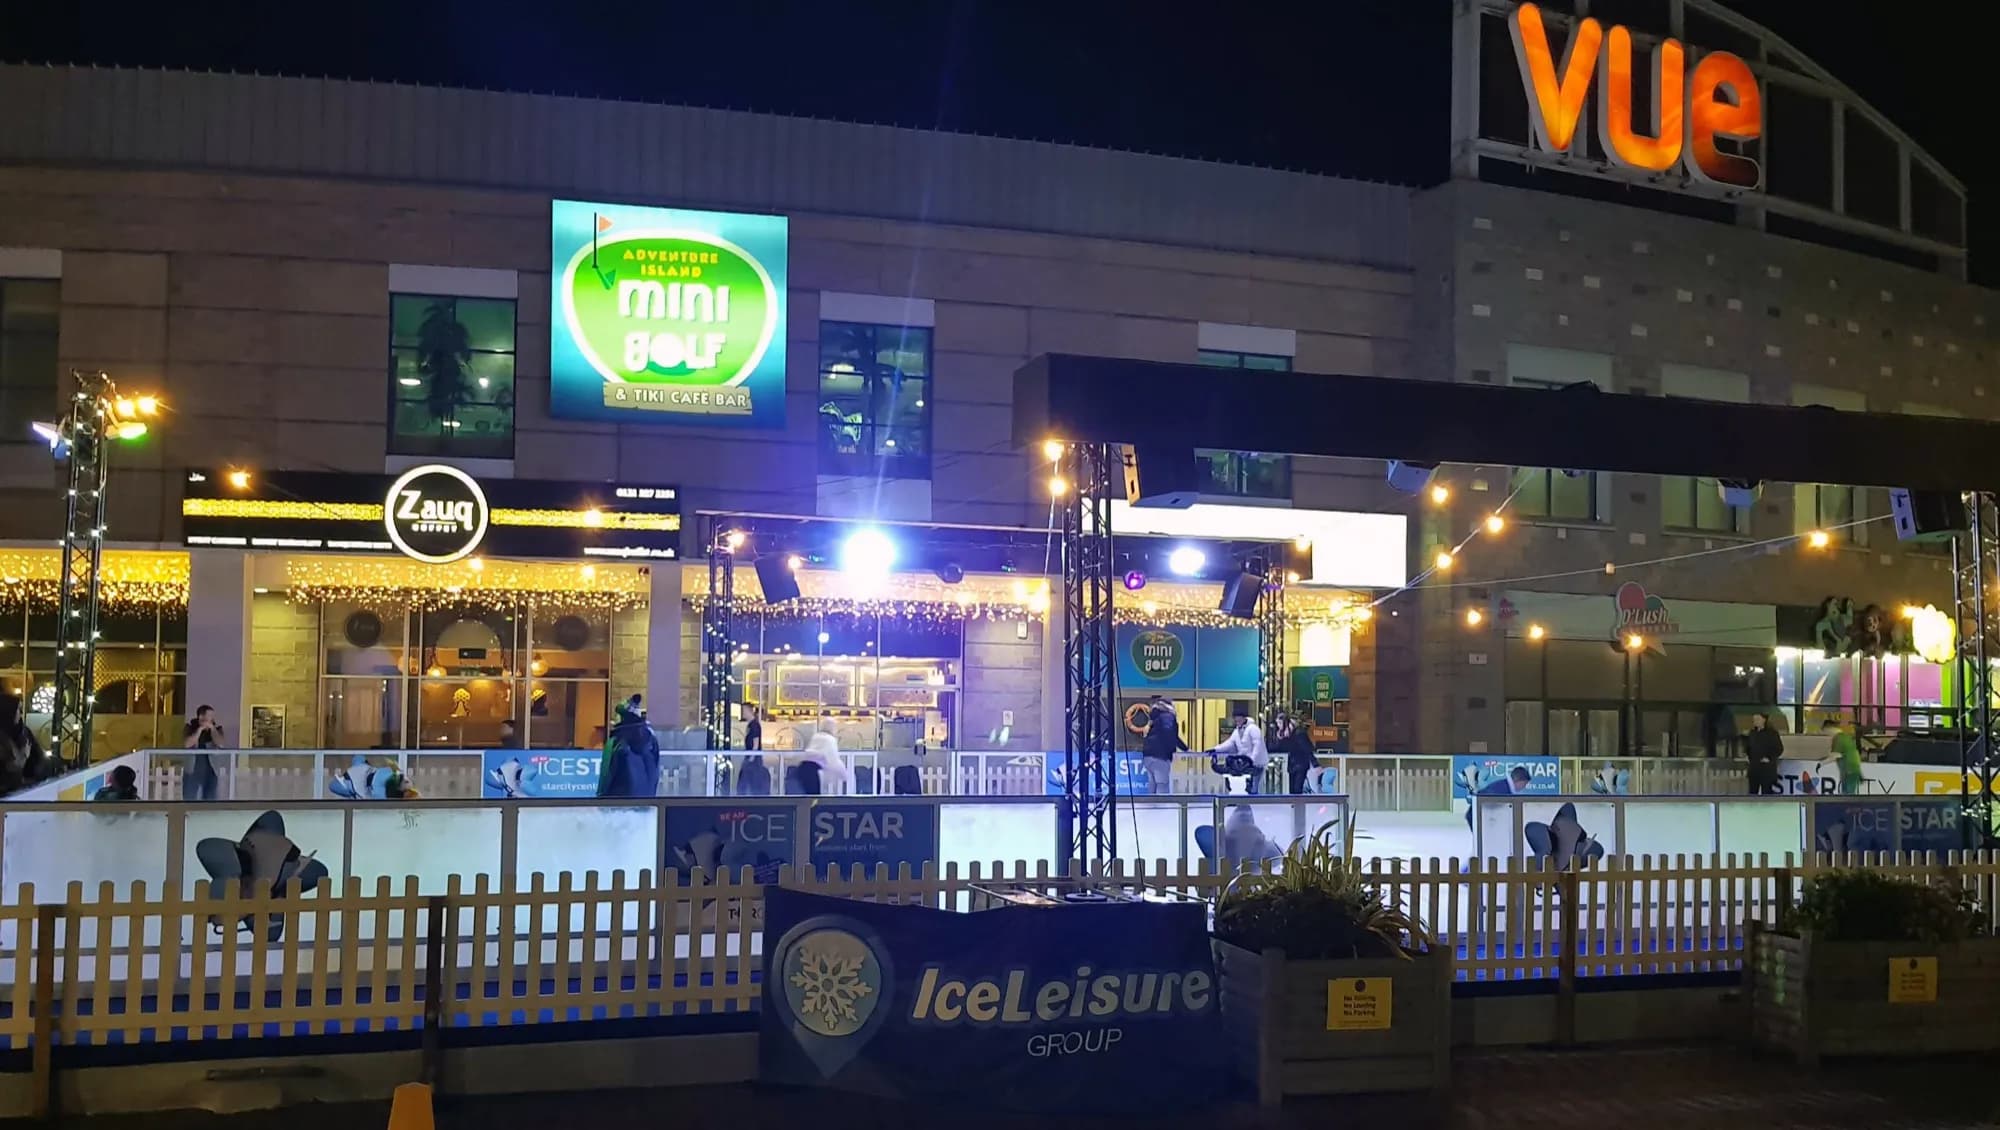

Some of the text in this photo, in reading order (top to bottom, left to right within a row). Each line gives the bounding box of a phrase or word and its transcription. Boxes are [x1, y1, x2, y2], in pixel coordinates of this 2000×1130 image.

[623, 248, 719, 264] ADVENTURE
[640, 265, 702, 278] ISLAND
[615, 388, 748, 408] & TIKI CAFE BAR
[397, 490, 474, 531] Zauq
[538, 758, 602, 776] ICEST
[730, 811, 904, 842] ICE STAR
[1901, 807, 1957, 831] STAR
[912, 966, 1210, 1023] IceLeisure
[1027, 1028, 1123, 1057] GROUP
